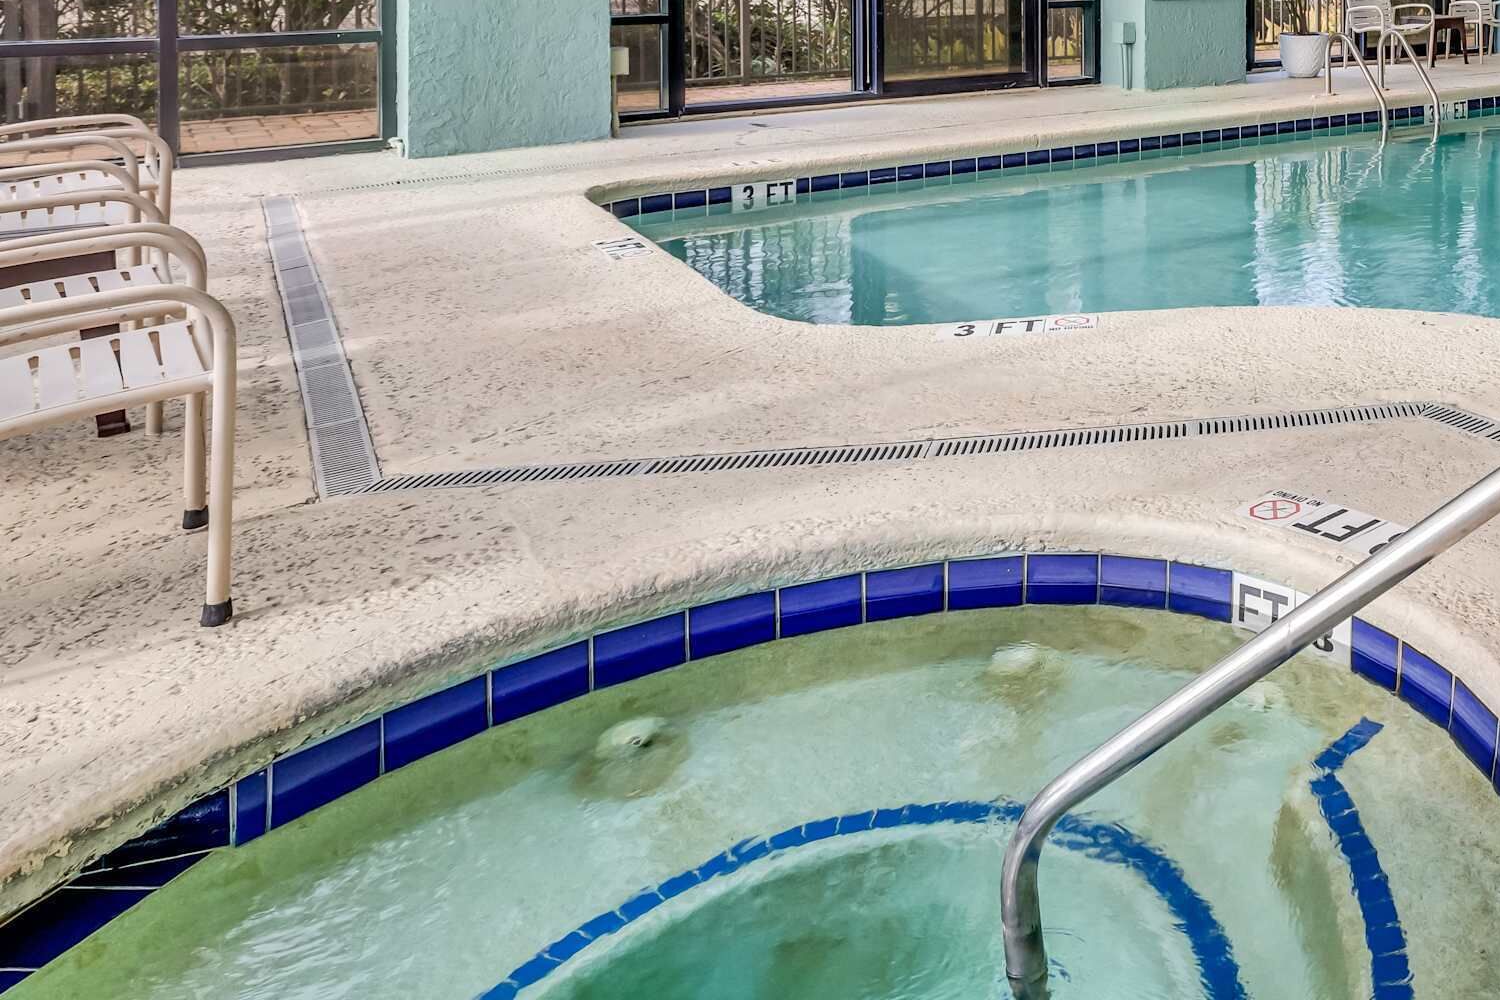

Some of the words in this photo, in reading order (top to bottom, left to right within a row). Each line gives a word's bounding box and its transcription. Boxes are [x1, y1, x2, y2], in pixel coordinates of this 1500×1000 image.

[743, 186, 754, 202] 3
[766, 181, 793, 201] FT
[954, 324, 975, 337] 3
[995, 320, 1043, 335] FT
[1272, 490, 1308, 502] DIVING
[1292, 508, 1381, 542] FT
[1238, 583, 1288, 623] FT
